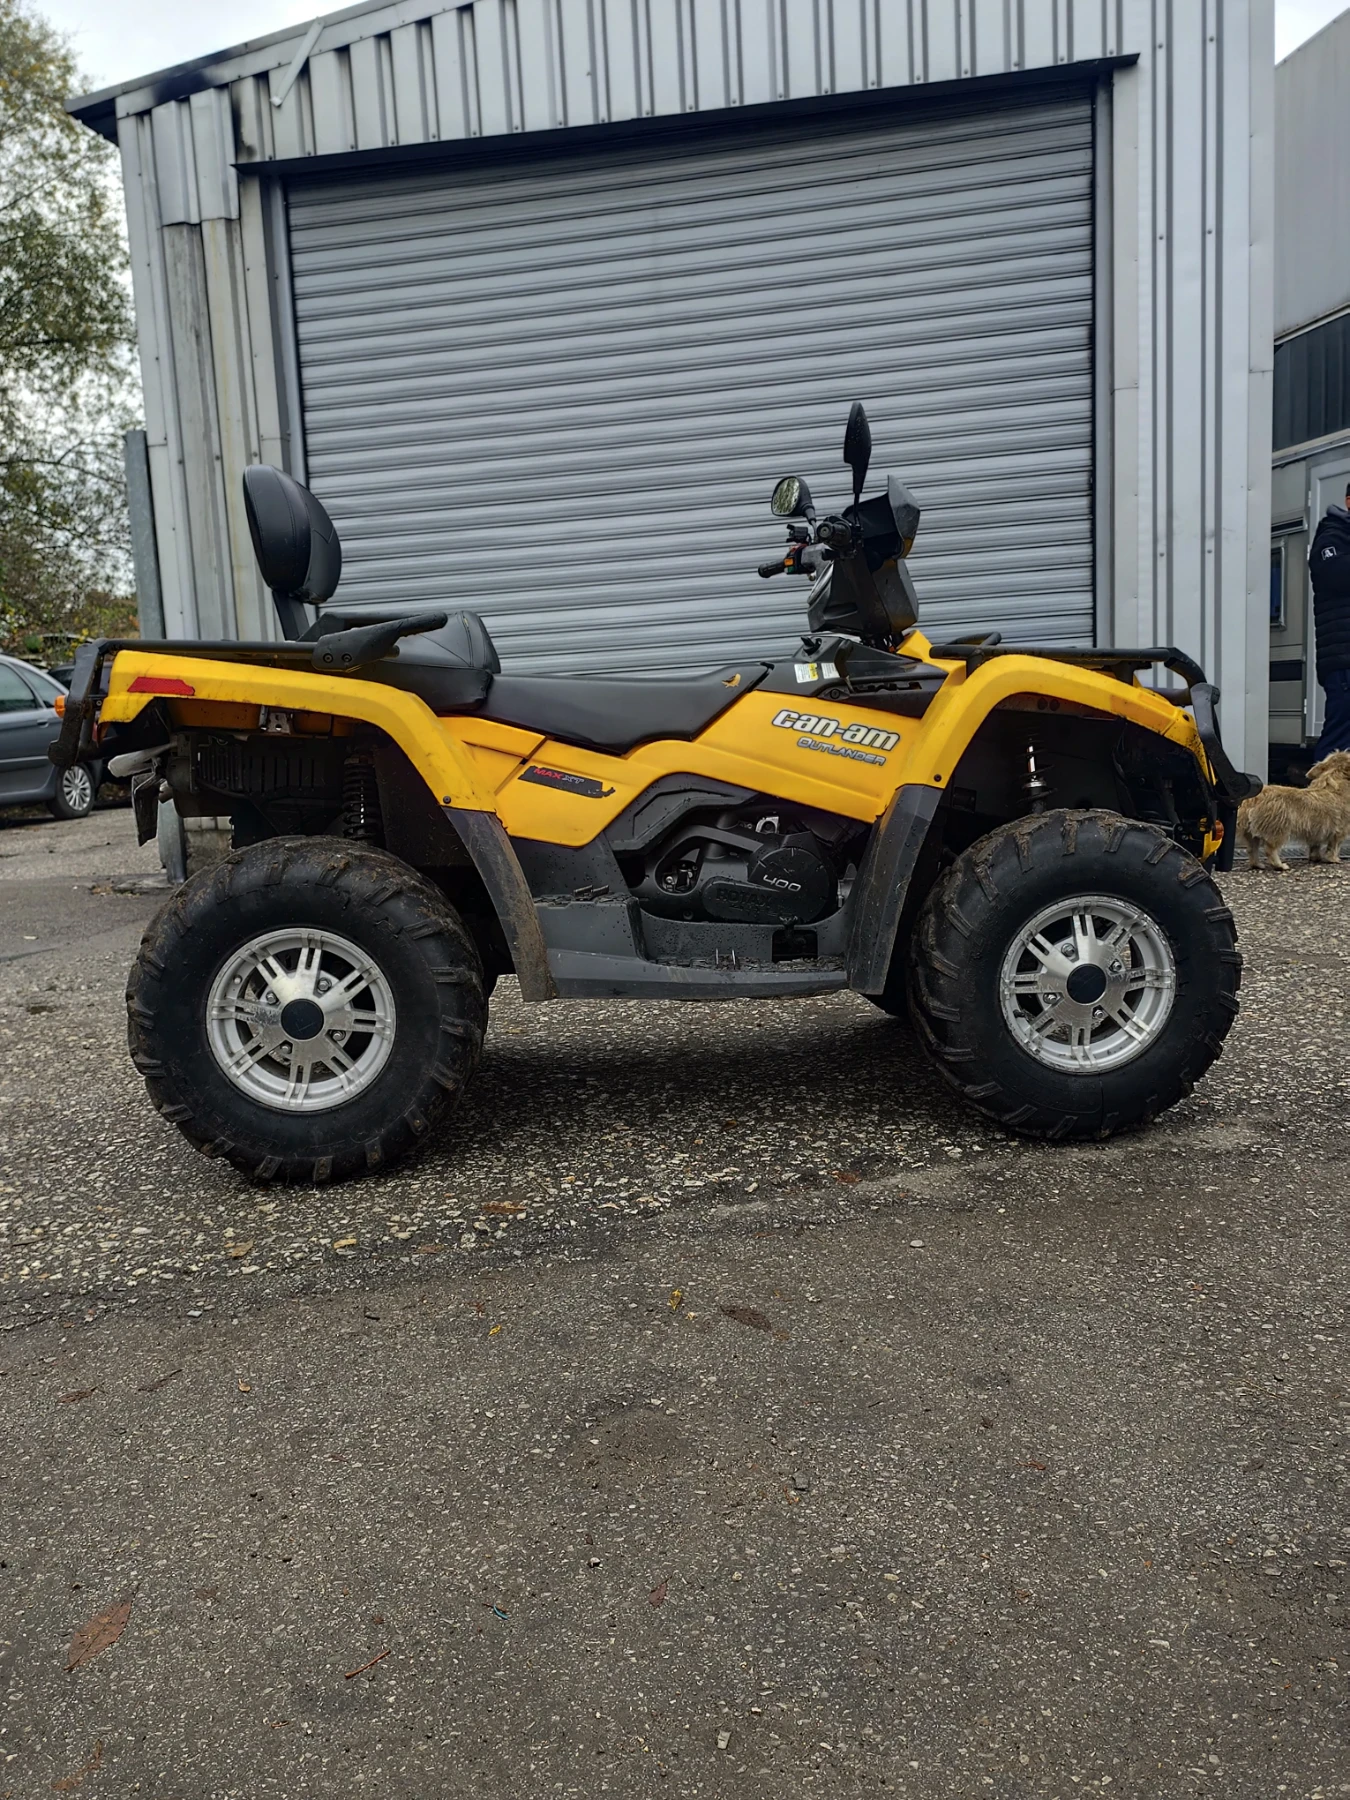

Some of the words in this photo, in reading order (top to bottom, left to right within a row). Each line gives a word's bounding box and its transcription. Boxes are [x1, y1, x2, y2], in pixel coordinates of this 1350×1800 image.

[772, 709, 900, 751] can-am
[797, 736, 887, 766] OUTLANDER
[533, 767, 563, 780] MAX
[763, 874, 802, 892] 400
